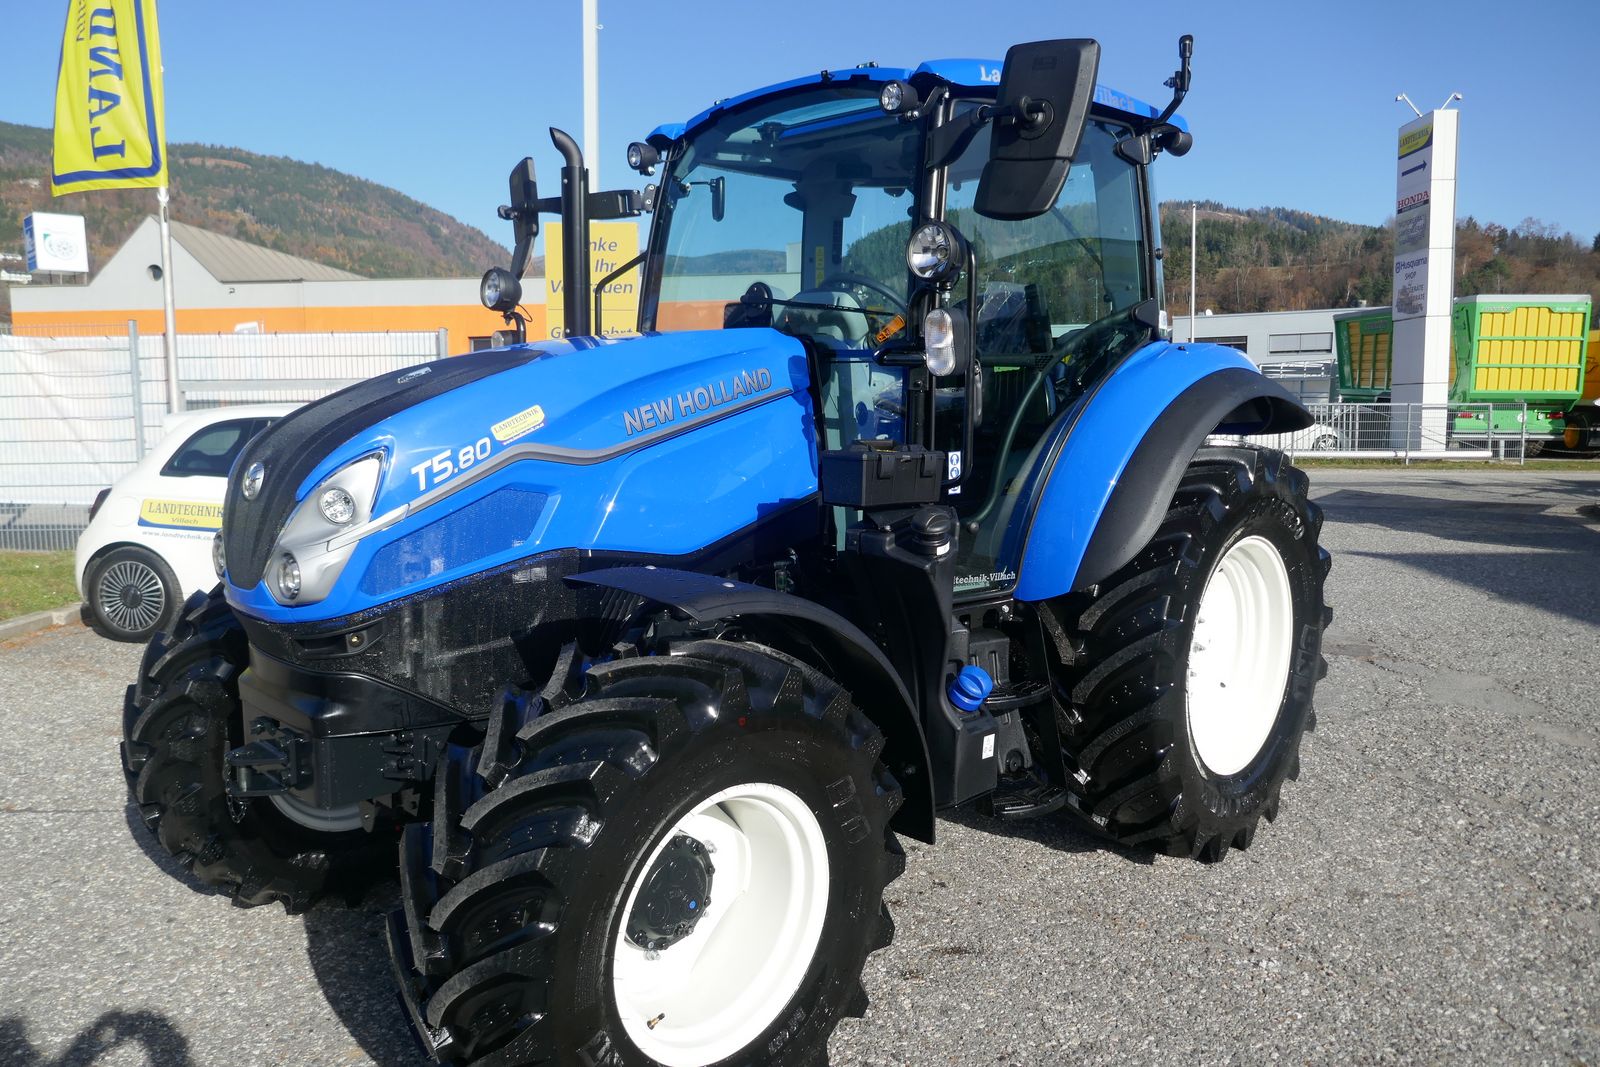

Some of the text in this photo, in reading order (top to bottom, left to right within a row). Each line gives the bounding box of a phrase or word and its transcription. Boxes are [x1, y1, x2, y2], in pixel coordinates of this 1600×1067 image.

[980, 64, 1001, 83] La
[1397, 190, 1430, 209] HONDA
[589, 237, 618, 252] nke
[594, 258, 617, 273] Ihr
[1400, 256, 1428, 270] Husqvarna
[623, 367, 772, 436] NEW HOLLAND
[493, 408, 539, 434] LANDTECHNIK
[410, 437, 491, 491] T5.80
[172, 517, 199, 525] Villach
